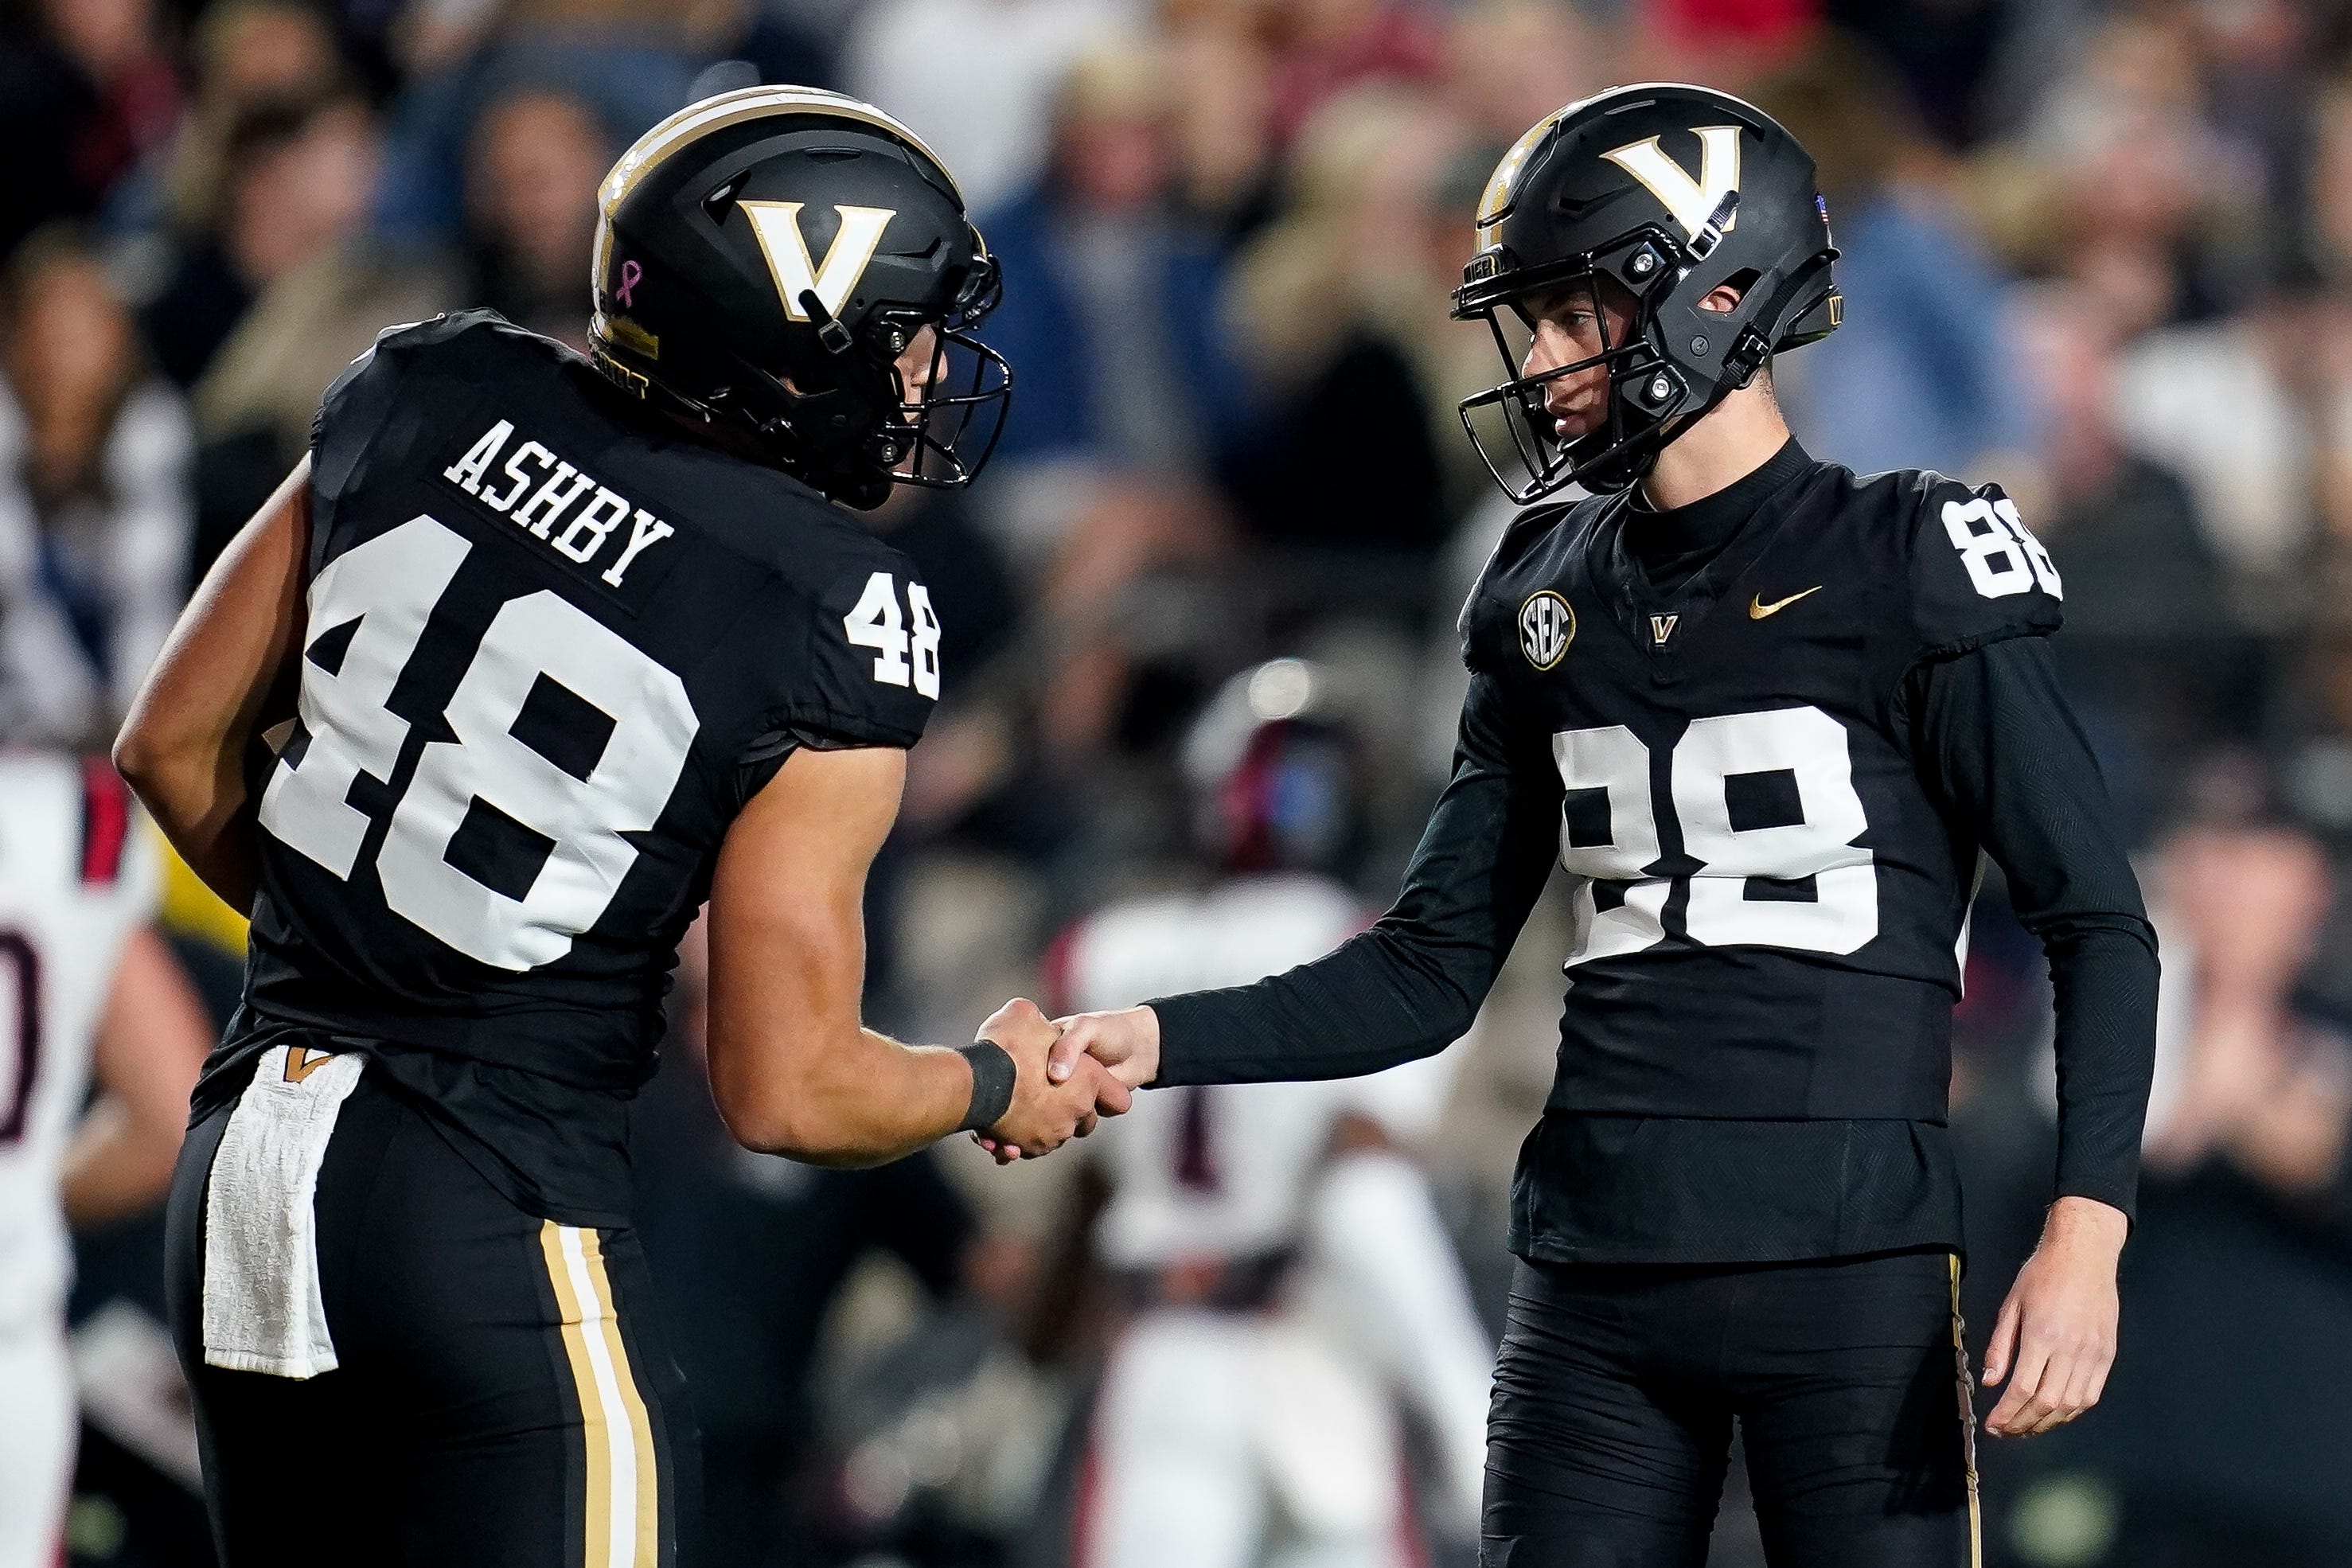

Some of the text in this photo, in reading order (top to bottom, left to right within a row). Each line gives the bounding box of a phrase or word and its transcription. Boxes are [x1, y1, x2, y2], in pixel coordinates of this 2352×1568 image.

[1598, 125, 1743, 236] V
[735, 200, 898, 322] V
[443, 419, 673, 587] ASHBY
[1940, 497, 2064, 602] 88
[843, 571, 941, 700] 48
[1523, 596, 1570, 665] SEC
[1649, 614, 1679, 643] V
[258, 513, 700, 972] 48
[1552, 705, 1878, 969] 88
